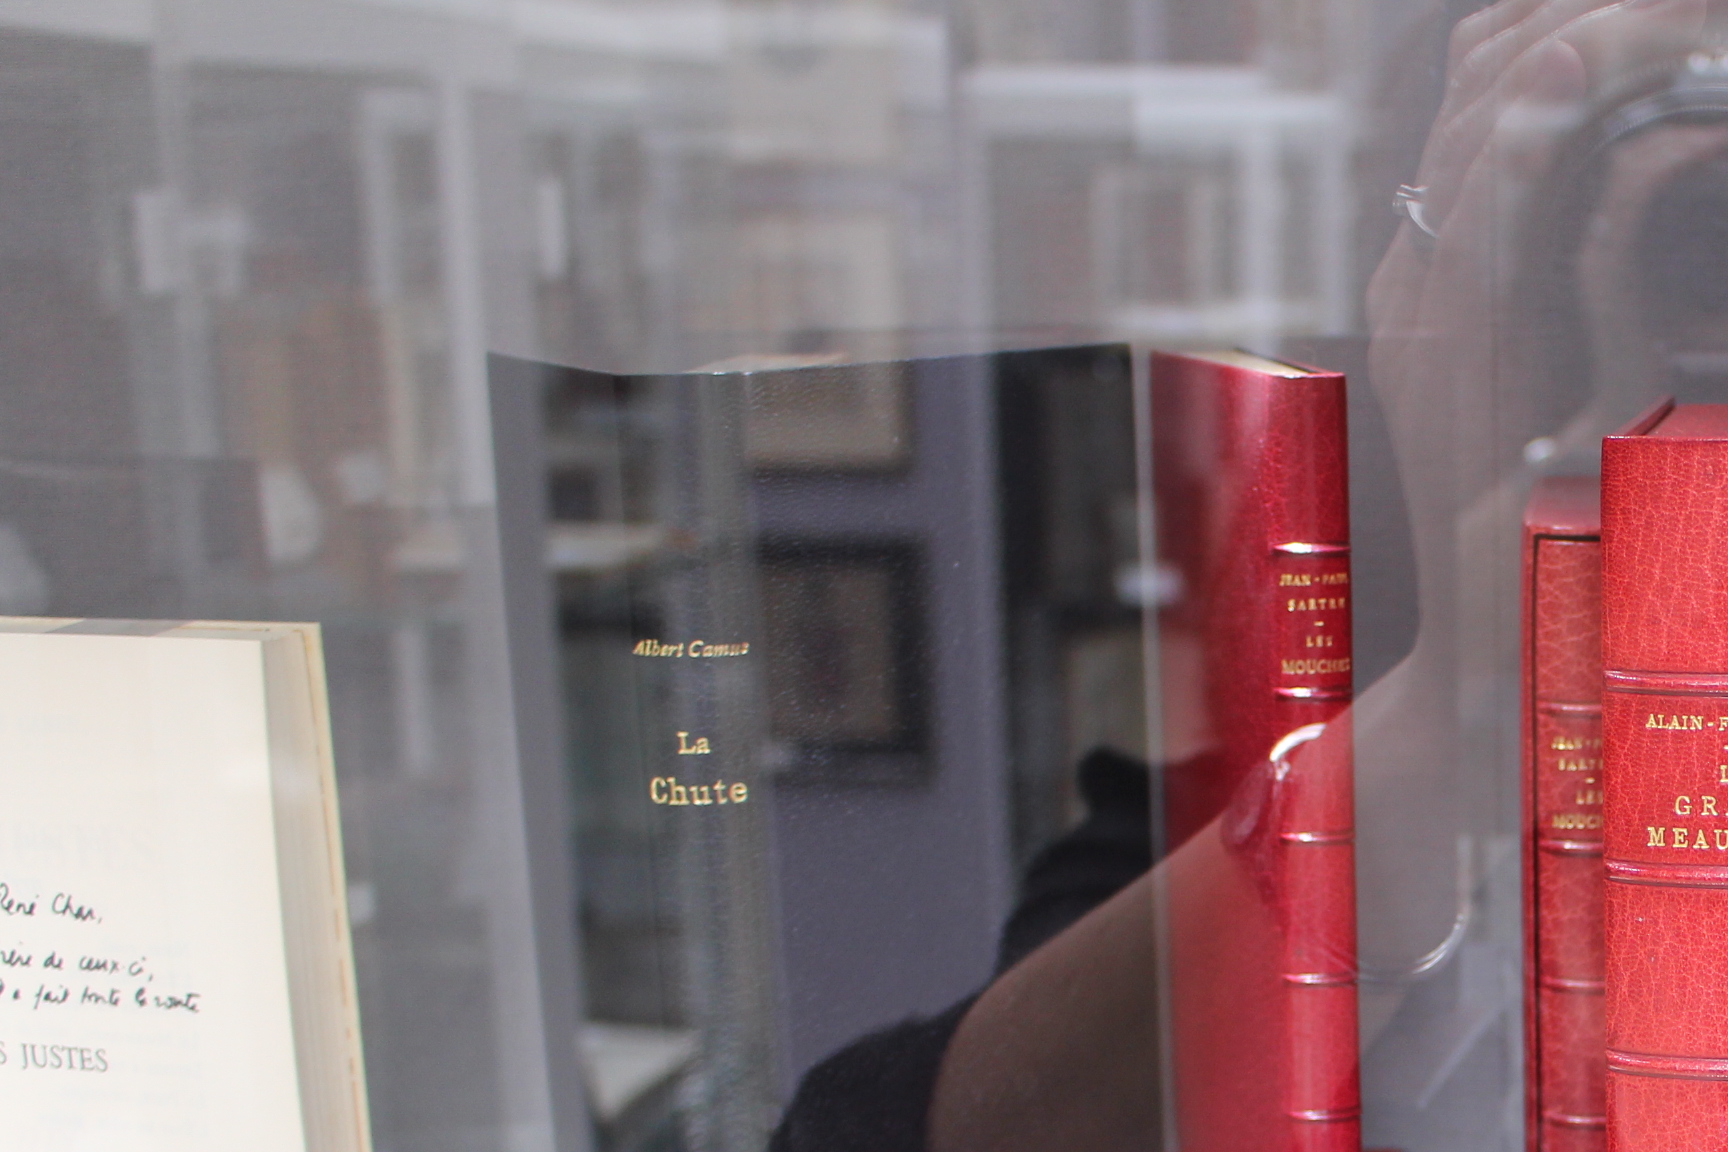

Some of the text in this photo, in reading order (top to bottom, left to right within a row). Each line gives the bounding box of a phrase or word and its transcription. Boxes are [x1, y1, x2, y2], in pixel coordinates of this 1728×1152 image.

[1287, 598, 1346, 612] SARTRE
[632, 639, 750, 658] Albert Camus
[1306, 635, 1334, 648] LES
[676, 731, 711, 755] La
[650, 776, 749, 805] Chute
[20, 1042, 109, 1073] JUSTES
